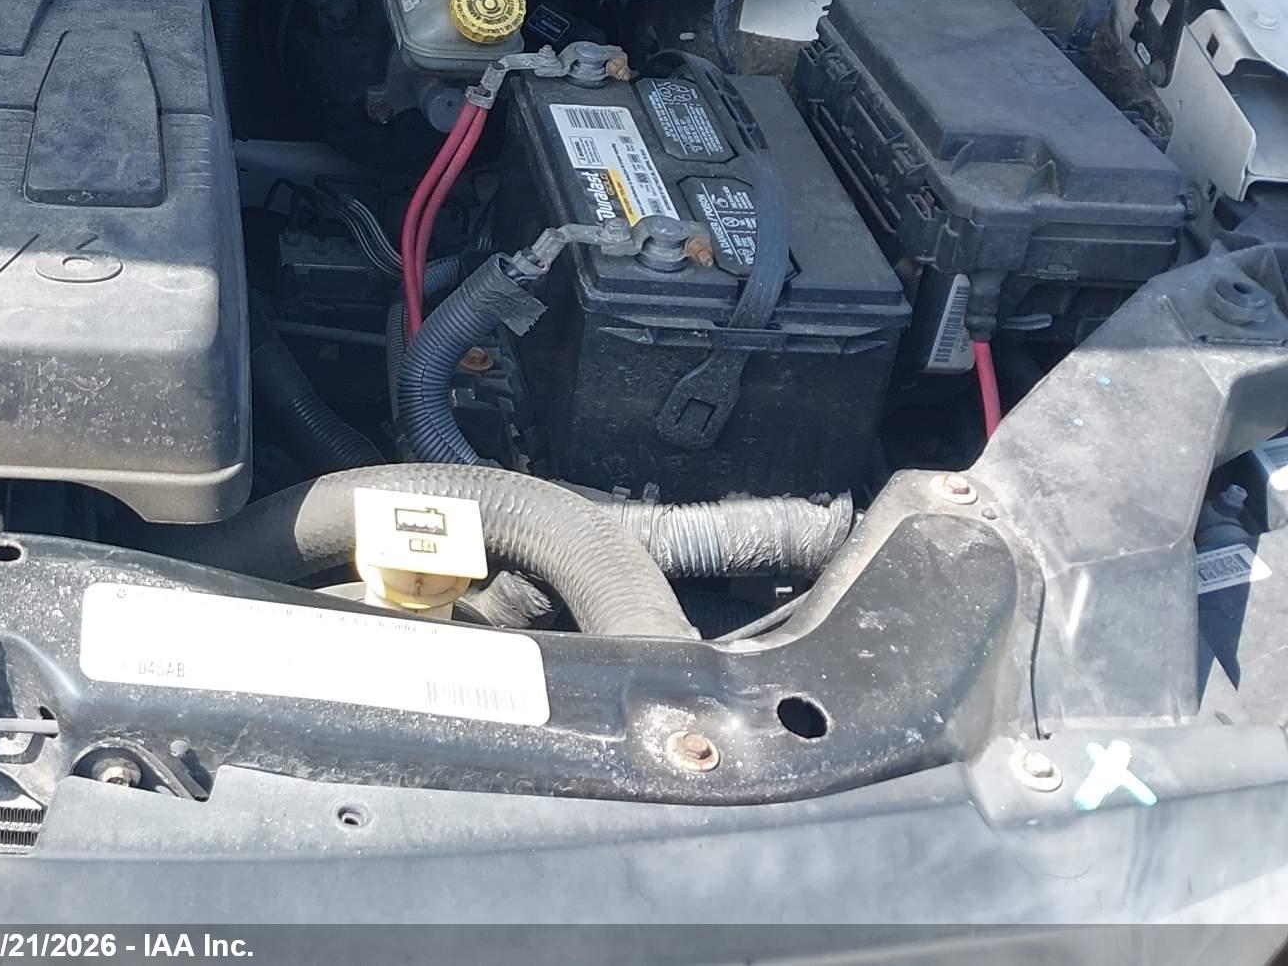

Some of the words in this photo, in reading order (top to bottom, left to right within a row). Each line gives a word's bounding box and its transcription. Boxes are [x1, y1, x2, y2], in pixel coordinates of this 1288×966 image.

[581, 172, 616, 221] Duralast
[696, 194, 715, 216] POISON
[710, 222, 730, 248] DANGER
